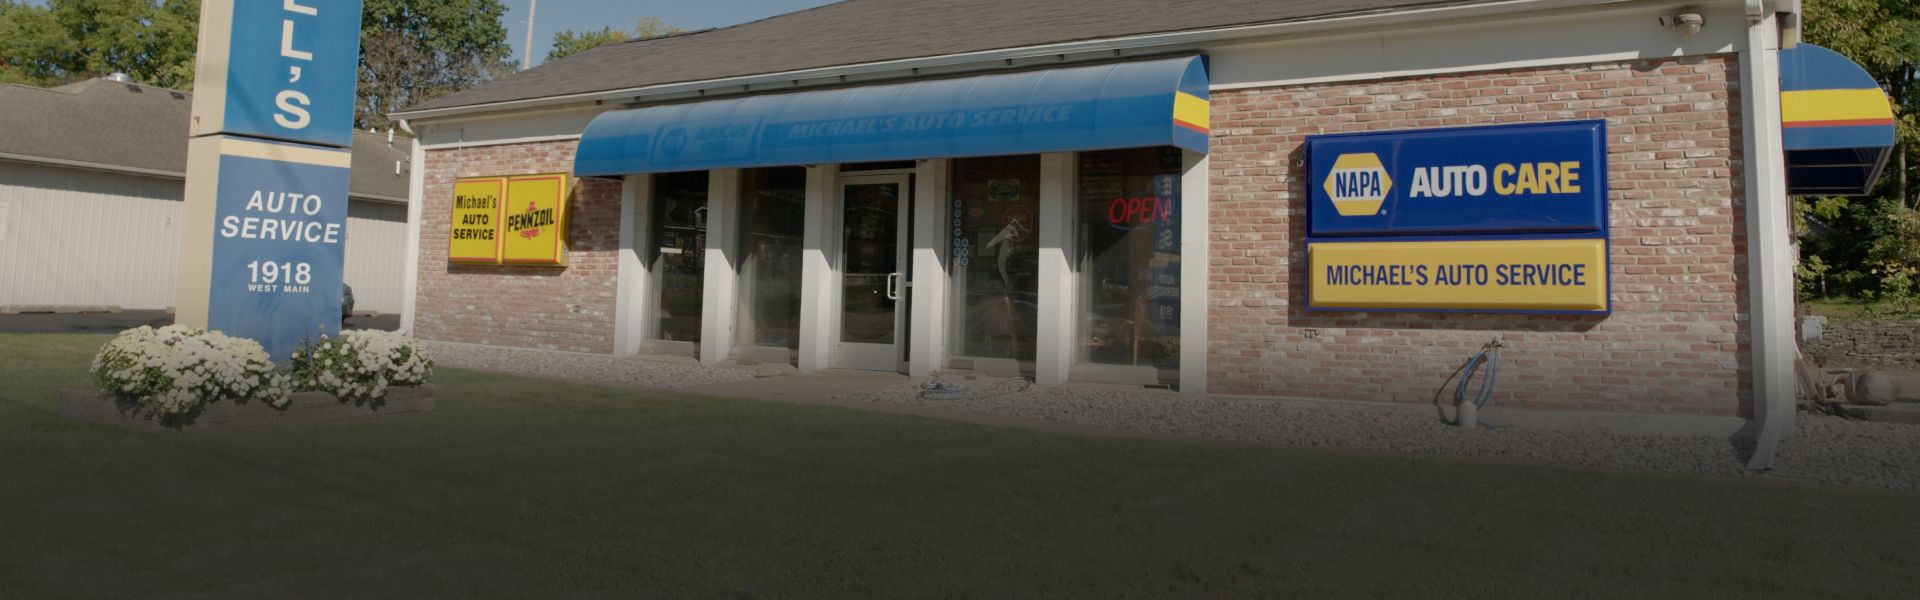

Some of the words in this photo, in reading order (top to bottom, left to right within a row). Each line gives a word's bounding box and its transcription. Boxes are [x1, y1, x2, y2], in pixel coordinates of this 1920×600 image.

[788, 116, 898, 139] MICHAEL'S
[900, 112, 966, 131] AUTO
[972, 104, 1075, 128] SERVICE
[1335, 171, 1382, 199] NAPA
[1409, 164, 1487, 198] AUTO
[1493, 161, 1581, 195] CARE
[245, 190, 322, 216] AUTO
[456, 195, 497, 209] Michael's
[1108, 197, 1170, 224] OPEN
[220, 215, 340, 244] SERVICE
[462, 214, 489, 225] AUTO
[508, 208, 555, 232] PENNZOIL
[453, 229, 494, 240] SERVICE
[247, 260, 311, 285] 1918
[1326, 264, 1428, 286] MICHAEL'S
[1435, 264, 1489, 286] AUTO
[1496, 264, 1586, 286] SERVICE
[248, 284, 278, 292] WEST
[283, 285, 310, 293] MAIN
